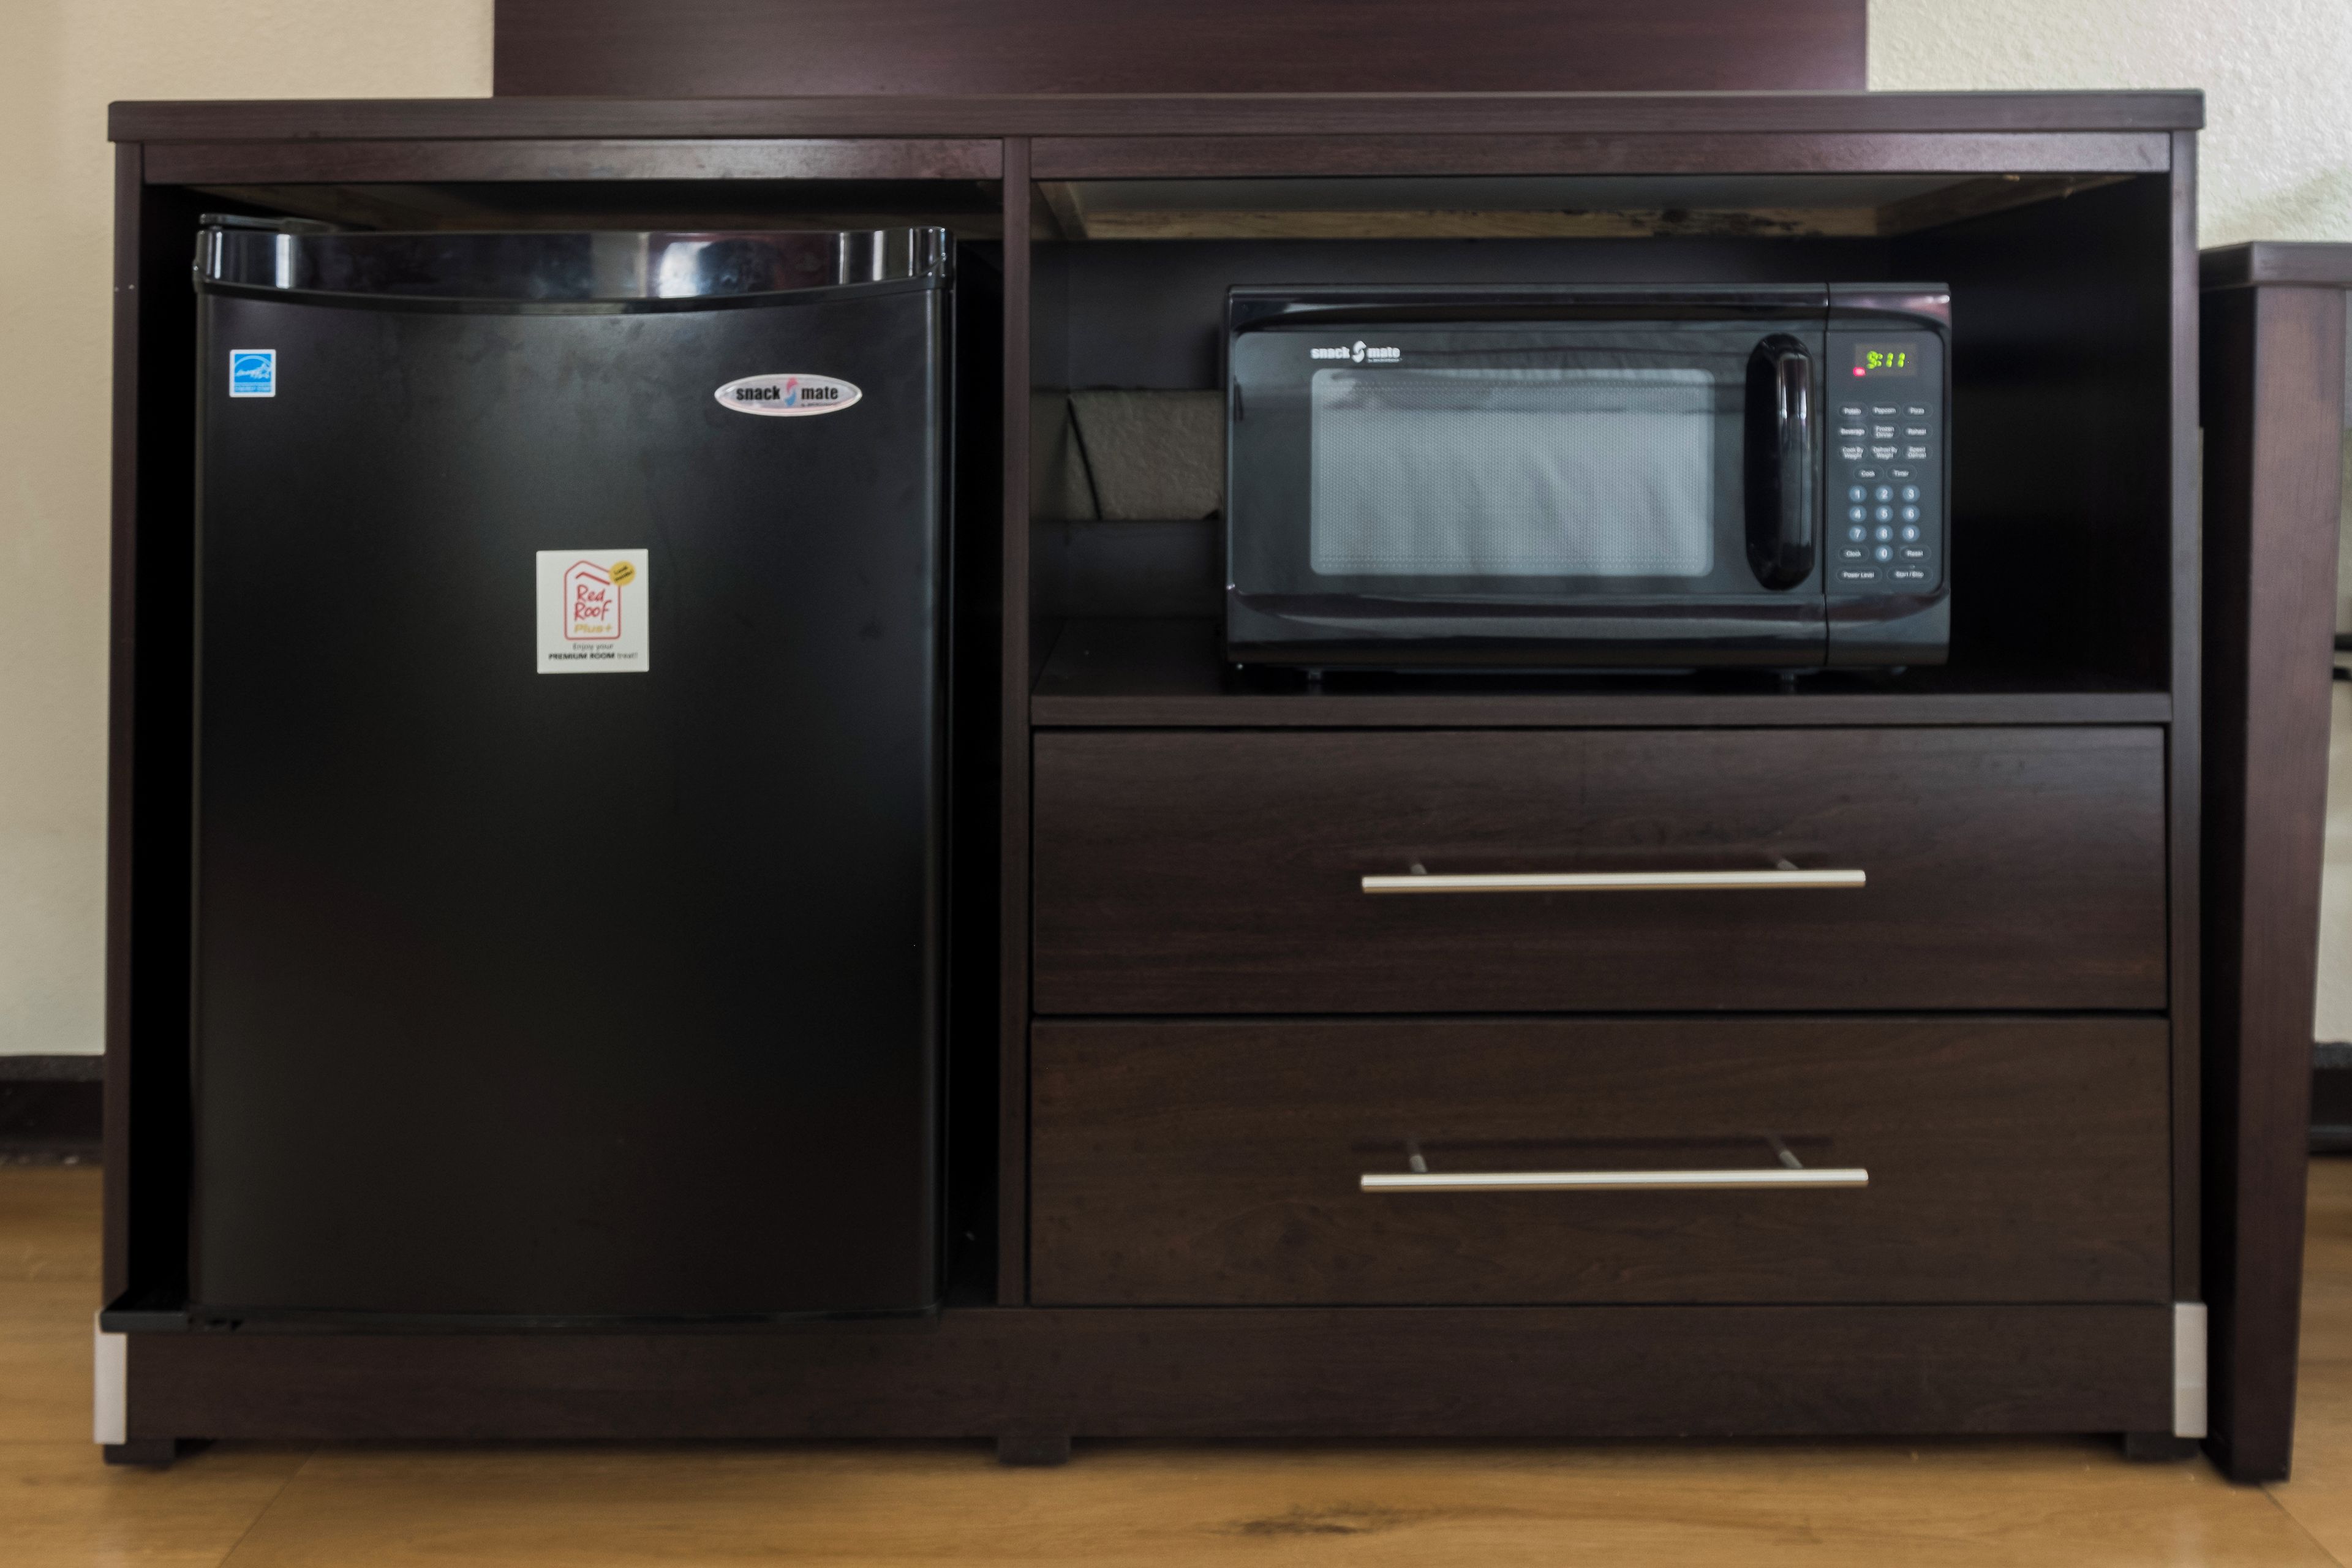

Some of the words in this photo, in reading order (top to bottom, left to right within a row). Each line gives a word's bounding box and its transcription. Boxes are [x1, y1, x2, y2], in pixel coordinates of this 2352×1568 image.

[1311, 347, 1351, 359] snack
[1366, 347, 1401, 358] mate
[736, 385, 781, 401] snack
[801, 386, 839, 400] mate
[1854, 489, 1861, 499] 1
[1882, 489, 1888, 500] 2
[1907, 489, 1915, 500] 3
[1854, 509, 1861, 519] 4
[1881, 508, 1888, 519] 5
[1907, 508, 1915, 519] 6
[1855, 528, 1862, 540] 7
[1881, 528, 1888, 540] 8
[1907, 528, 1915, 540] 9
[1881, 548, 1888, 559] 0
[576, 584, 606, 603] Red
[574, 600, 612, 621] Roof
[574, 624, 612, 633] Plus+
